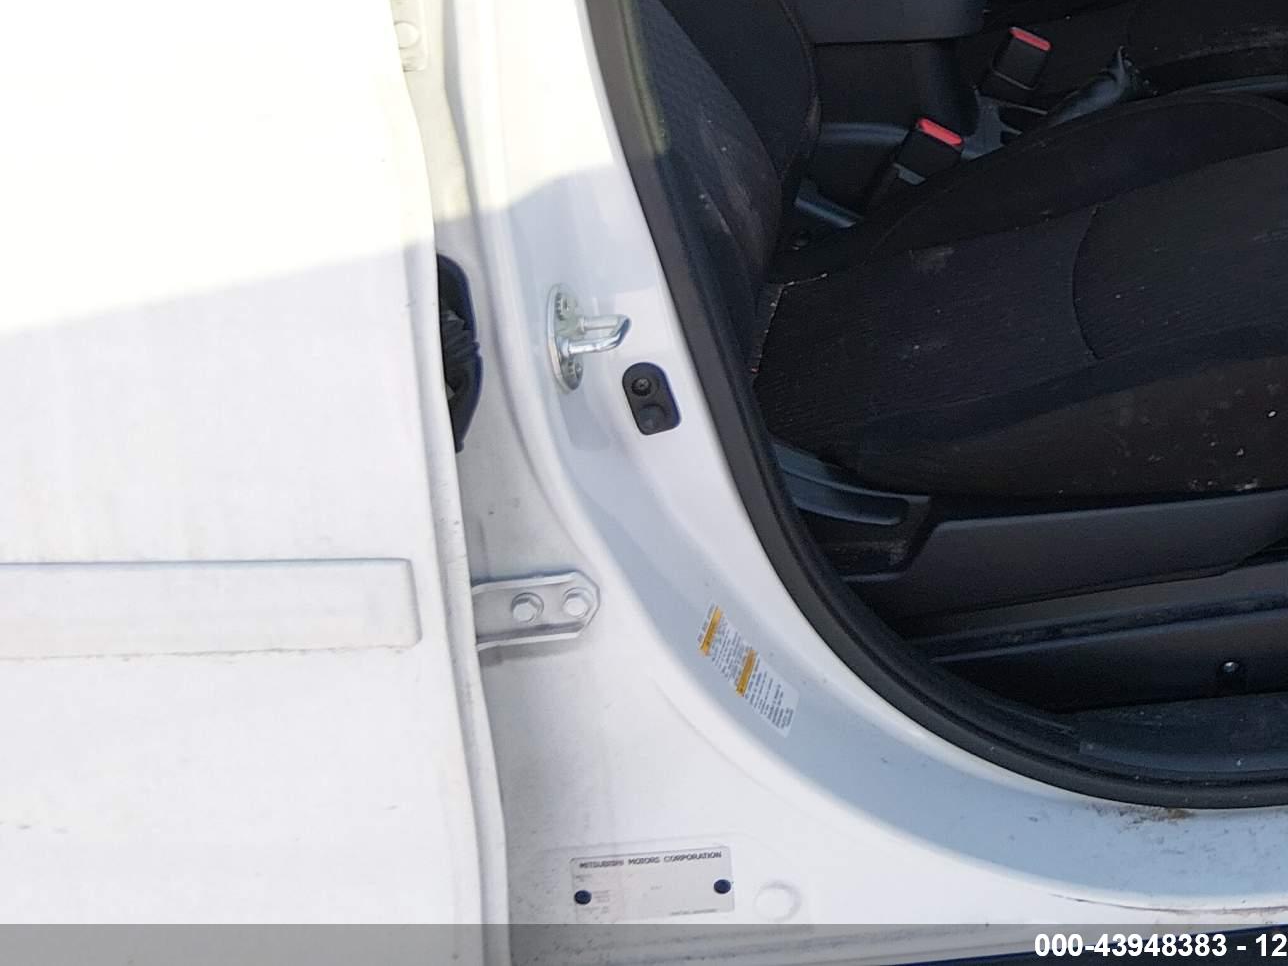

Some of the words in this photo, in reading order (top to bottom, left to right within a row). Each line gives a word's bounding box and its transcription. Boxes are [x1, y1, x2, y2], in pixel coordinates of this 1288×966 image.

[579, 859, 624, 869] MITSUBISHI
[628, 857, 660, 865] MOTORS
[664, 852, 722, 863] CORPORATION
